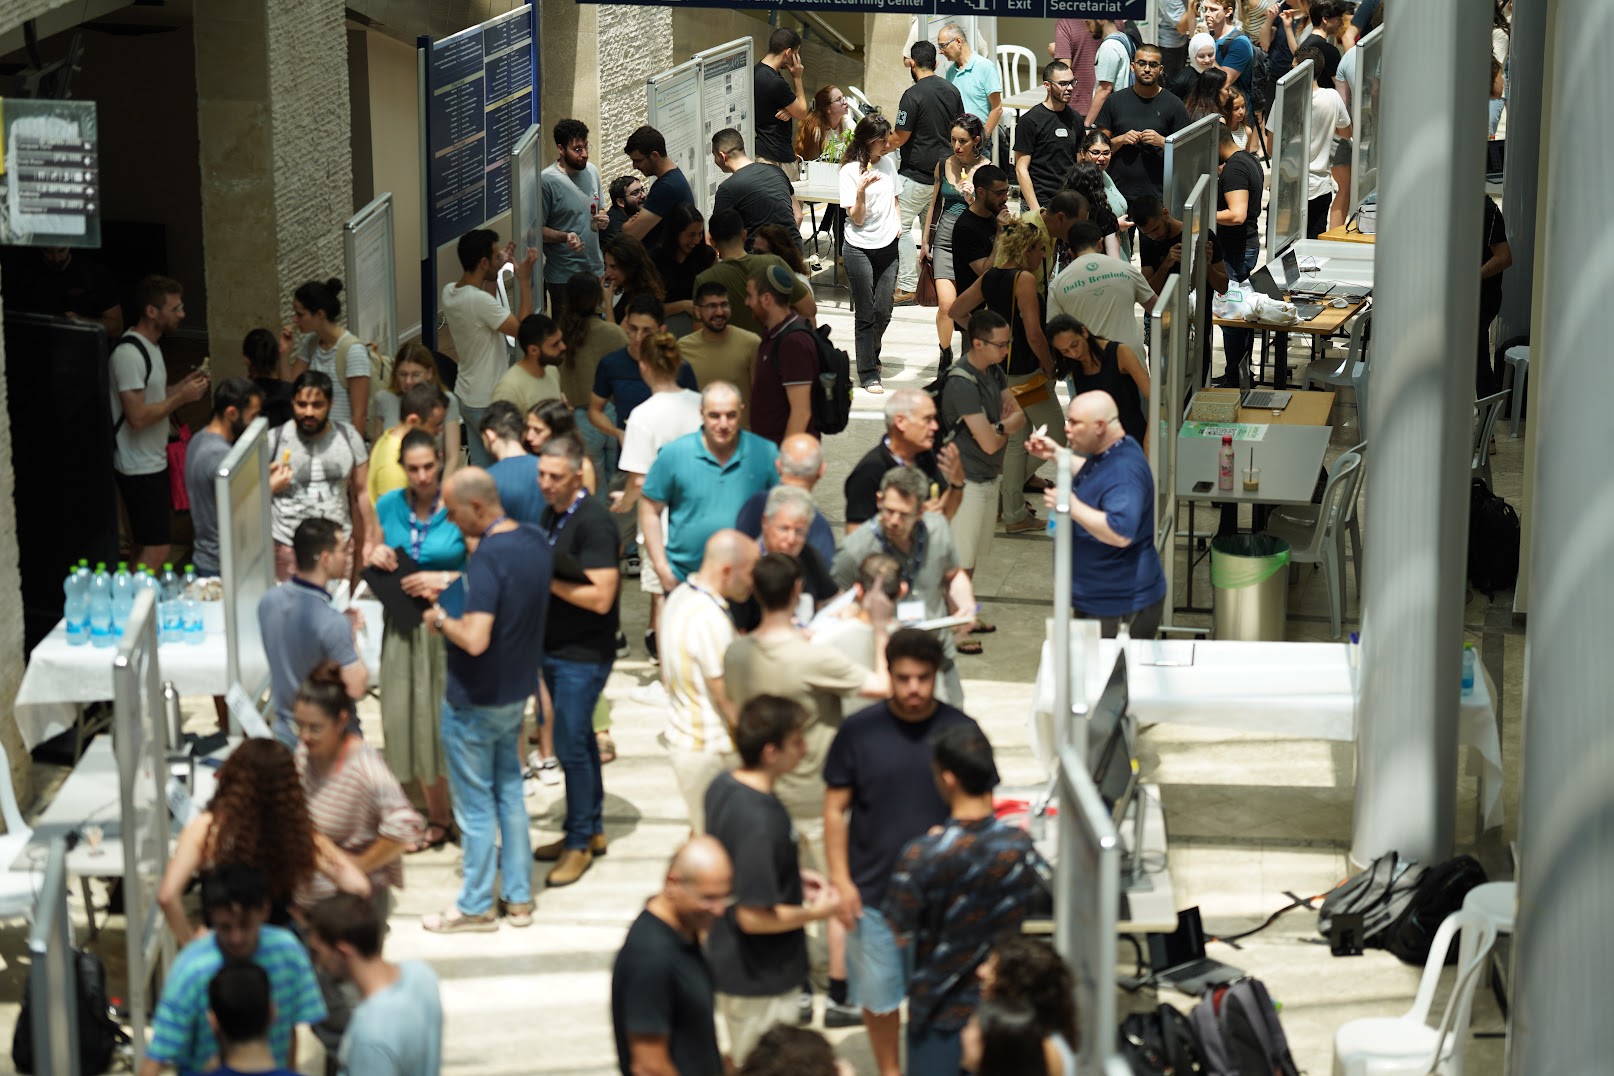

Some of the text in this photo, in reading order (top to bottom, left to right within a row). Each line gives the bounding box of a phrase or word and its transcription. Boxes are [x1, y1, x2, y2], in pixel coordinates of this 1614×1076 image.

[1008, 0, 1031, 9] Exit
[1050, 0, 1121, 12] Secretariat
[1063, 280, 1086, 293] Daily
